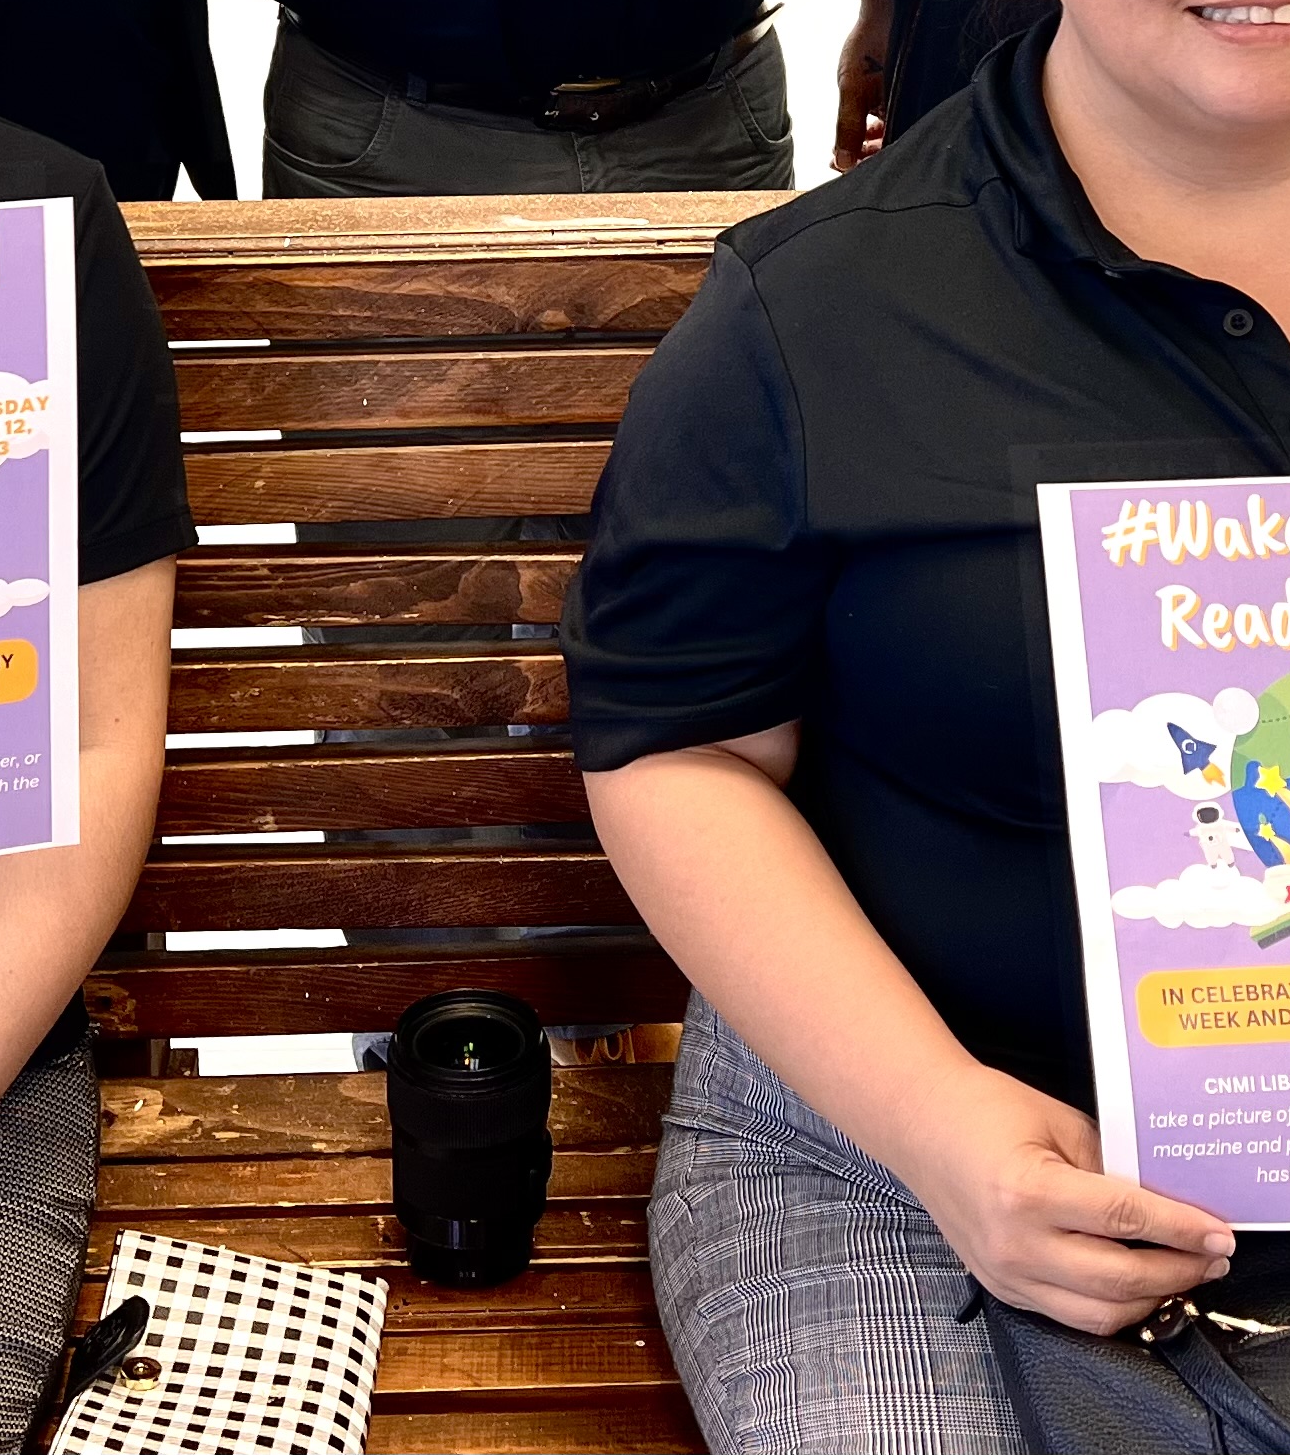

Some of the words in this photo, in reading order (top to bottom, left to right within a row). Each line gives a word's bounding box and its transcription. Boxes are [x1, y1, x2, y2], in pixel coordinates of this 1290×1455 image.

[4, 418, 32, 434] 12,
[23, 753, 41, 764] or
[13, 776, 39, 790] the
[1161, 988, 1183, 1005] IN
[1178, 1011, 1240, 1029] WEEK
[1204, 1075, 1255, 1094] CNMI
[1148, 1110, 1187, 1128] take
[1192, 1113, 1204, 1126] a
[1208, 1108, 1271, 1129] picture
[1153, 1138, 1242, 1160] magazine
[1246, 1134, 1281, 1153] and
